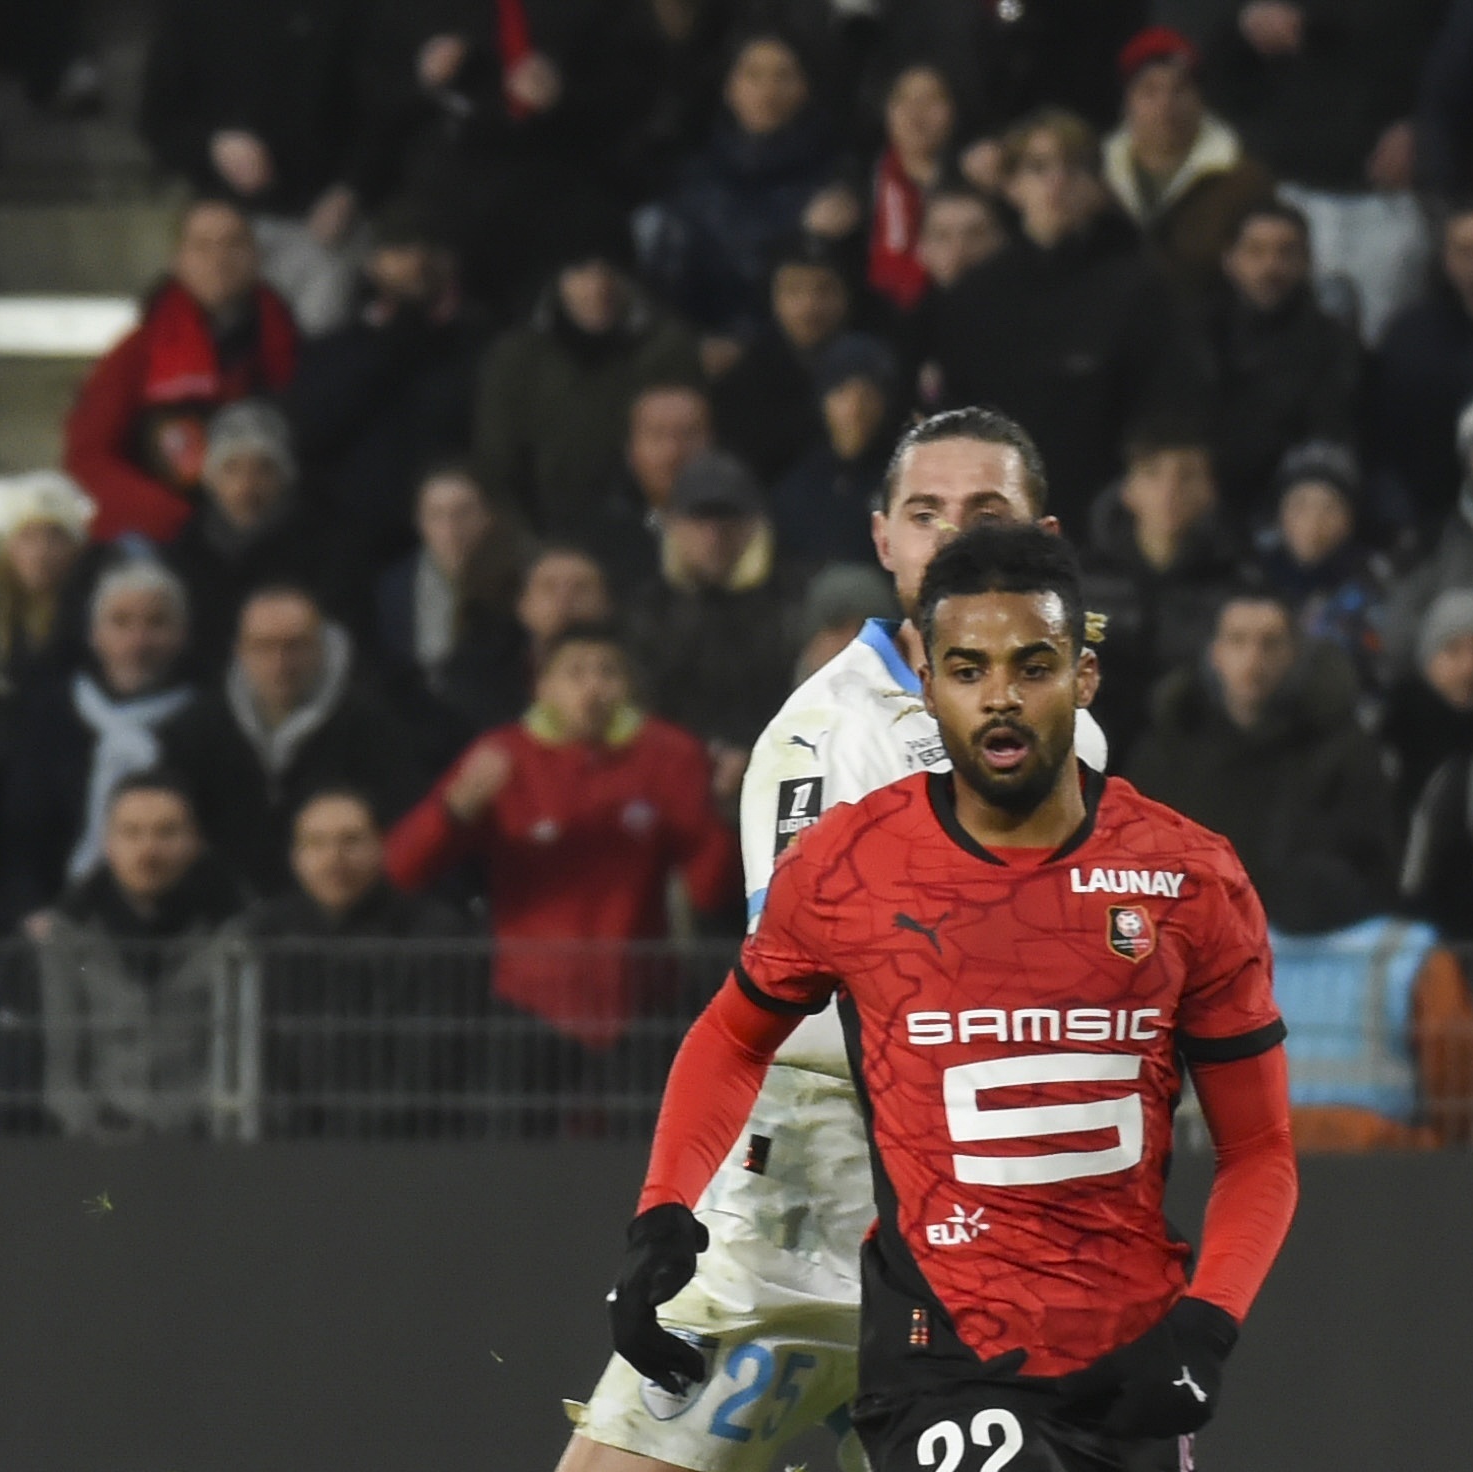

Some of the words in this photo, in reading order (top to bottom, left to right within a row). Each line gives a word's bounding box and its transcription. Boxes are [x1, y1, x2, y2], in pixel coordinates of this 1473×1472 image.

[1070, 867, 1185, 898] LAUNAY
[907, 1008, 1161, 1045] SAMSIC
[708, 1343, 818, 1442] 25
